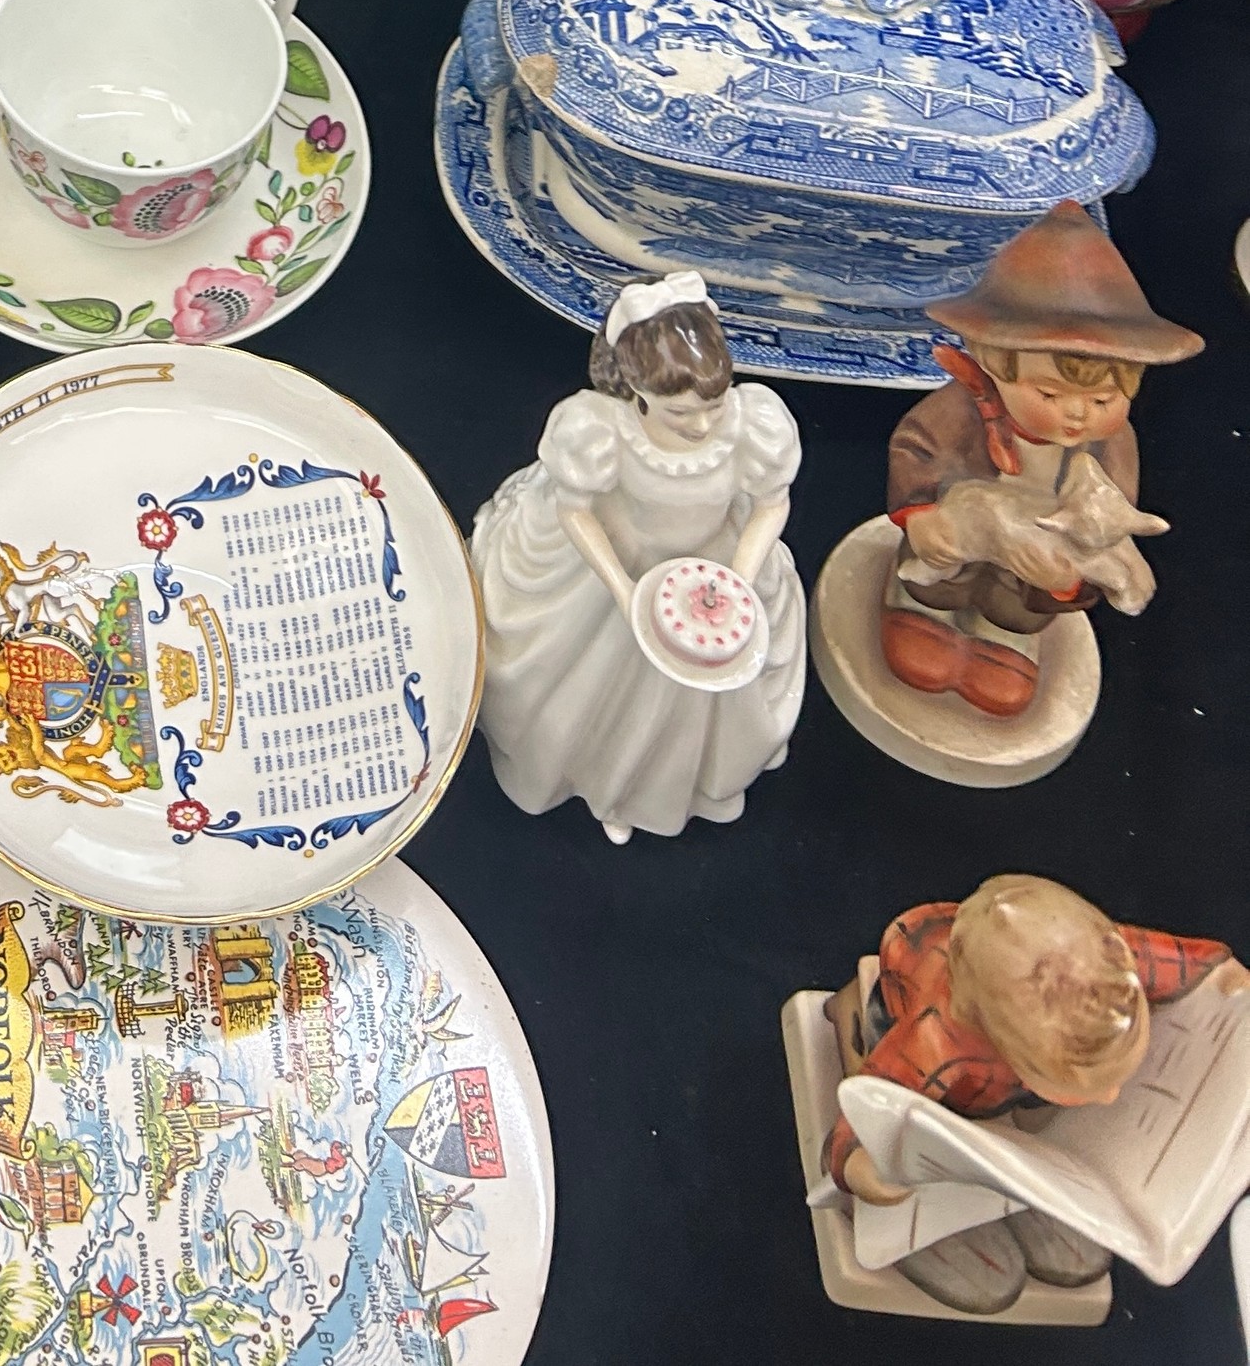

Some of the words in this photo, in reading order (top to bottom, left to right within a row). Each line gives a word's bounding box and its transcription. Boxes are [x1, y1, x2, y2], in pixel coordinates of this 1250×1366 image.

[34, 391, 52, 407] II
[61, 374, 100, 394] 1977
[304, 568, 314, 598] GEORGE
[314, 561, 325, 596] WILLIAM
[324, 556, 335, 593] VICTORIA
[335, 557, 346, 590] EDWARD
[345, 558, 355, 588] GEORGE
[355, 553, 366, 585] EDWARD
[366, 553, 376, 583] GEORGE
[242, 576, 251, 609] WILLIAM
[265, 585, 273, 605] ANNE
[274, 574, 284, 604] GEORGE
[284, 572, 294, 603] GEORGE
[295, 570, 305, 600] GEORGE
[388, 605, 396, 613] II
[203, 616, 222, 658] QUEENS
[390, 617, 406, 675] ELIZABETH
[216, 664, 226, 687] AND
[230, 643, 240, 688] CONFESSOR
[352, 658, 362, 697] ELIZABETH
[364, 669, 372, 693] JAMES
[372, 658, 383, 691] CHARLES
[382, 656, 394, 689] CHARLES
[246, 692, 254, 717] HENRY
[257, 691, 265, 716] HENRY
[268, 683, 277, 715] EDWARD
[278, 682, 287, 714] EDWARD
[290, 680, 298, 712] RICHARD
[302, 686, 310, 710] HENRY
[312, 684, 320, 708] HENRY
[322, 675, 331, 706] EDWARD
[344, 678, 352, 700] MARY
[239, 716, 248, 749] EDWARD
[323, 774, 331, 804] RICHARD
[356, 769, 365, 798] EDWARD
[367, 766, 376, 796] EDWARD
[378, 764, 387, 794] EDWARD
[389, 760, 398, 791] RICHARD
[280, 786, 288, 813] WILLIAM
[302, 779, 310, 808] STEPHEN
[39, 909, 79, 966] BRANDON
[339, 896, 370, 959] Wash
[367, 907, 386, 989] HUNSTANTON
[196, 979, 209, 1009] ACRE
[205, 969, 219, 1012] CASTLE
[185, 1013, 206, 1040] Sign
[352, 993, 369, 1043] MARKET
[177, 1025, 191, 1048] the
[268, 1013, 285, 1078] FAKENHAM
[95, 1075, 107, 1105] NEW
[347, 1052, 365, 1106] WELLS
[130, 1056, 148, 1137] NORWICH
[97, 1109, 118, 1187] BUCKENHAM
[143, 1173, 156, 1222] THORPE
[179, 1171, 193, 1237] WROXHAM
[200, 1153, 228, 1229] WROXHAM
[376, 1167, 403, 1236] BLAKENEY
[137, 1243, 151, 1311] BRUNDALL
[152, 1258, 168, 1303] UPTON
[179, 1240, 199, 1293] BROADS
[344, 1232, 382, 1324] SHERINGHAM
[283, 1247, 328, 1323] Norfolk
[375, 1258, 406, 1313] Sailing
[203, 1285, 229, 1325] BROAD
[346, 1292, 369, 1354] CROMER
